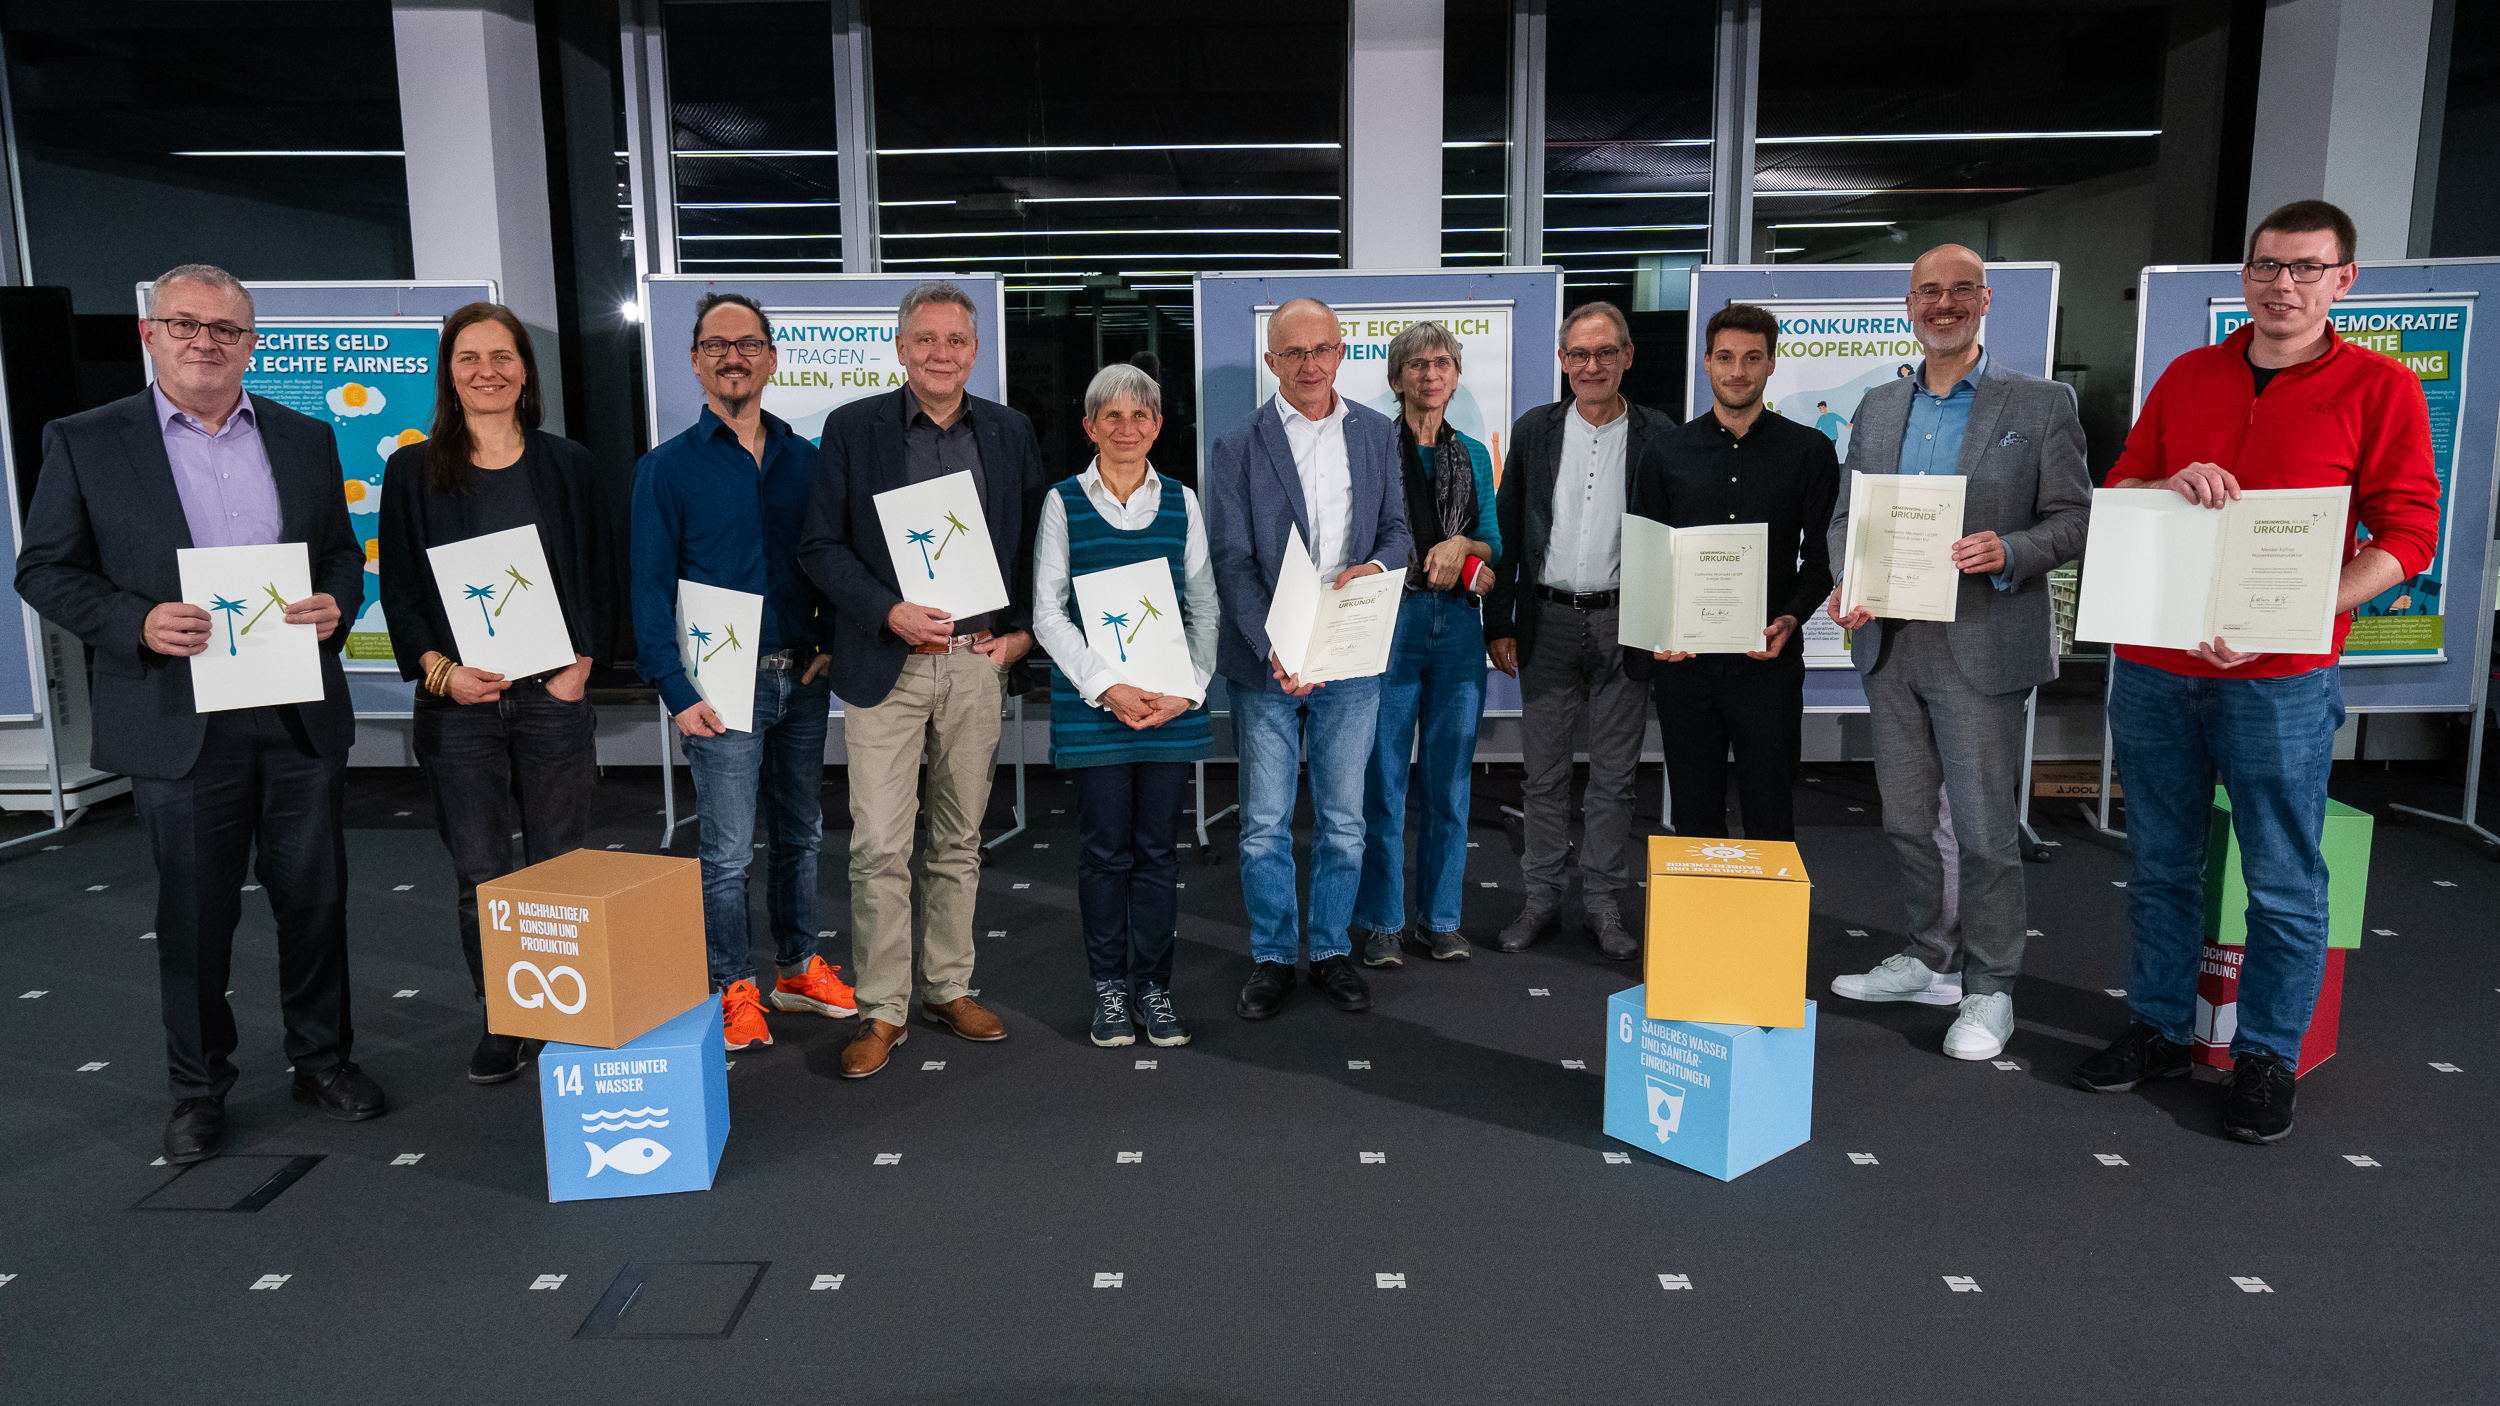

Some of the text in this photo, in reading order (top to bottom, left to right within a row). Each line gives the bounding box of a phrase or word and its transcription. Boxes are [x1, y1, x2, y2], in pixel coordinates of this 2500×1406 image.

[1779, 317, 1912, 335] KONKURREN
[2326, 313, 2459, 333] EMOKRATIE
[255, 334, 389, 351] ECHTES GELD
[263, 356, 328, 373] ECHTE
[333, 357, 429, 374] FAIRNESS
[785, 348, 864, 365] TRAGEN
[841, 367, 880, 387] FÜR
[1891, 510, 1937, 521] URKUNDE
[2253, 525, 2310, 534] URKUNDE
[1338, 597, 1376, 609] URKUNDE
[1692, 867, 1764, 875] BEZAHLBARE
[1711, 863, 1762, 871] SAUBERE
[488, 899, 512, 932] 12
[517, 901, 590, 924] NACHHALTIGE/R
[519, 918, 578, 939] KONSUM UND
[520, 936, 579, 956] PRODUKTION
[1620, 1012, 1633, 1044] 6
[1641, 1019, 1728, 1061] SAUBERES WASSER
[1641, 1035, 1702, 1068] UND SANITÄR-
[594, 1058, 668, 1077] LEBEN UNTER
[1640, 1051, 1711, 1089] EINRICHTUNGEN
[553, 1064, 584, 1097] 14
[595, 1077, 644, 1094] WASSER
